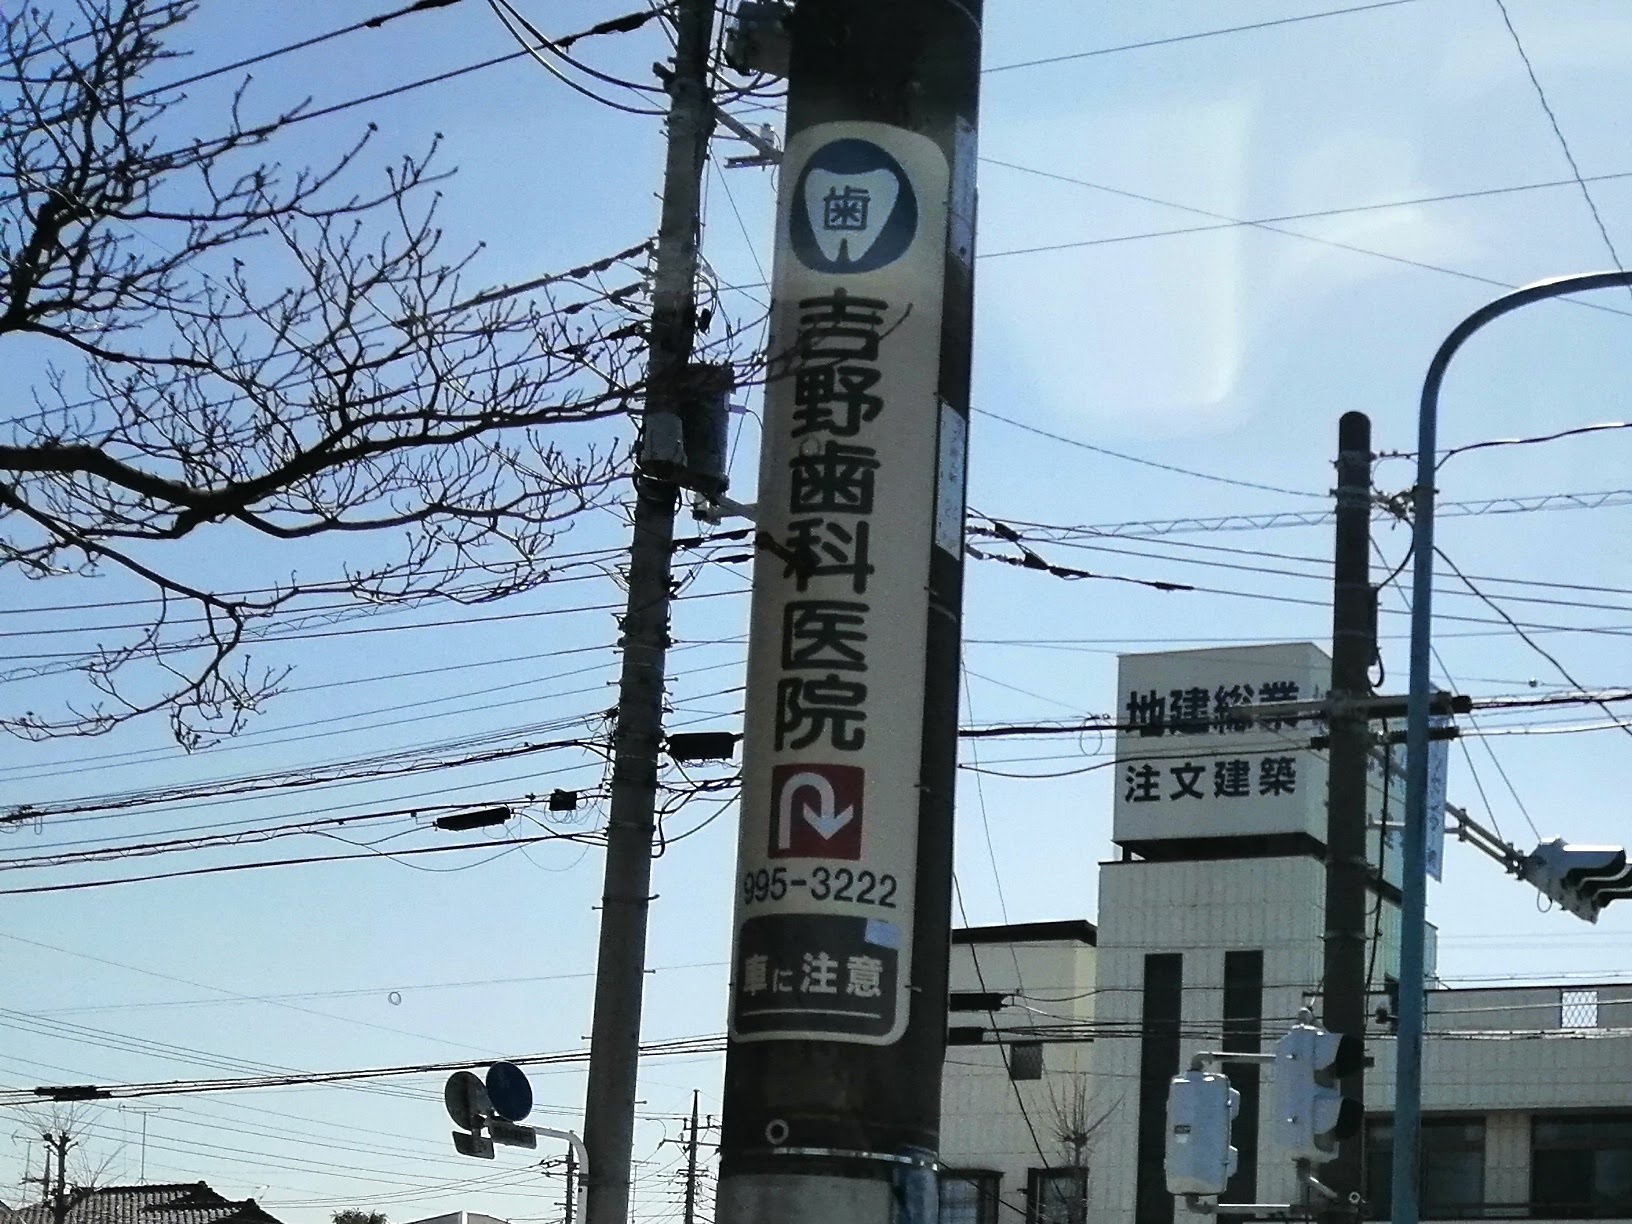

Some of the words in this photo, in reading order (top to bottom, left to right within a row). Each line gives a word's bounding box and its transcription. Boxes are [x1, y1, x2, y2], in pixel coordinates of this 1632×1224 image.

[822, 184, 871, 231] 歯
[1125, 756, 1298, 803] 注文建築
[742, 867, 899, 909] 995-3222
[742, 951, 884, 999] 車に注意
